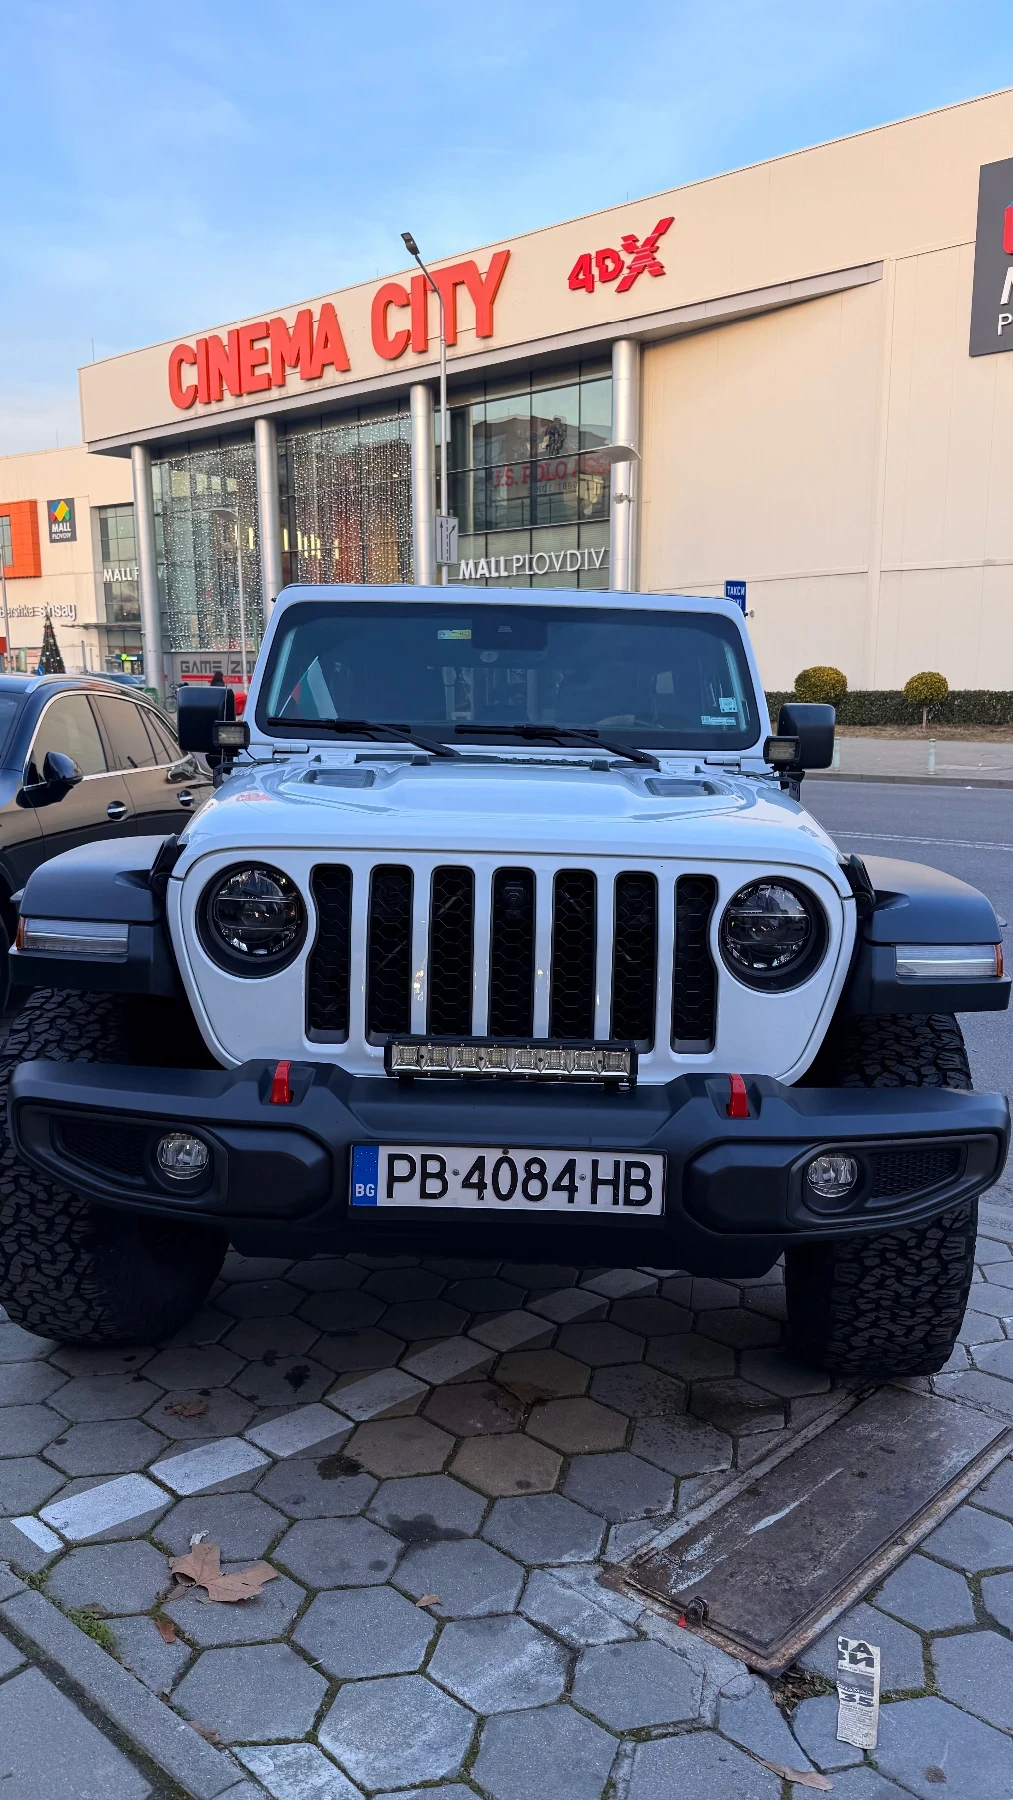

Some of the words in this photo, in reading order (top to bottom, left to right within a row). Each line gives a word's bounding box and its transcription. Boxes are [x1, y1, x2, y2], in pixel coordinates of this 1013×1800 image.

[567, 216, 676, 293] 4DX
[168, 303, 351, 409] CINEMA
[371, 249, 510, 360] CITY
[52, 522, 72, 533] MALL
[103, 568, 133, 582] MALL
[459, 556, 508, 580] MALL
[512, 547, 606, 576] PLOVDIV
[181, 661, 222, 674] GAME
[355, 1183, 375, 1198] BG
[387, 1153, 448, 1200] PB
[461, 1155, 578, 1204] 4084
[590, 1159, 652, 1206] HB
